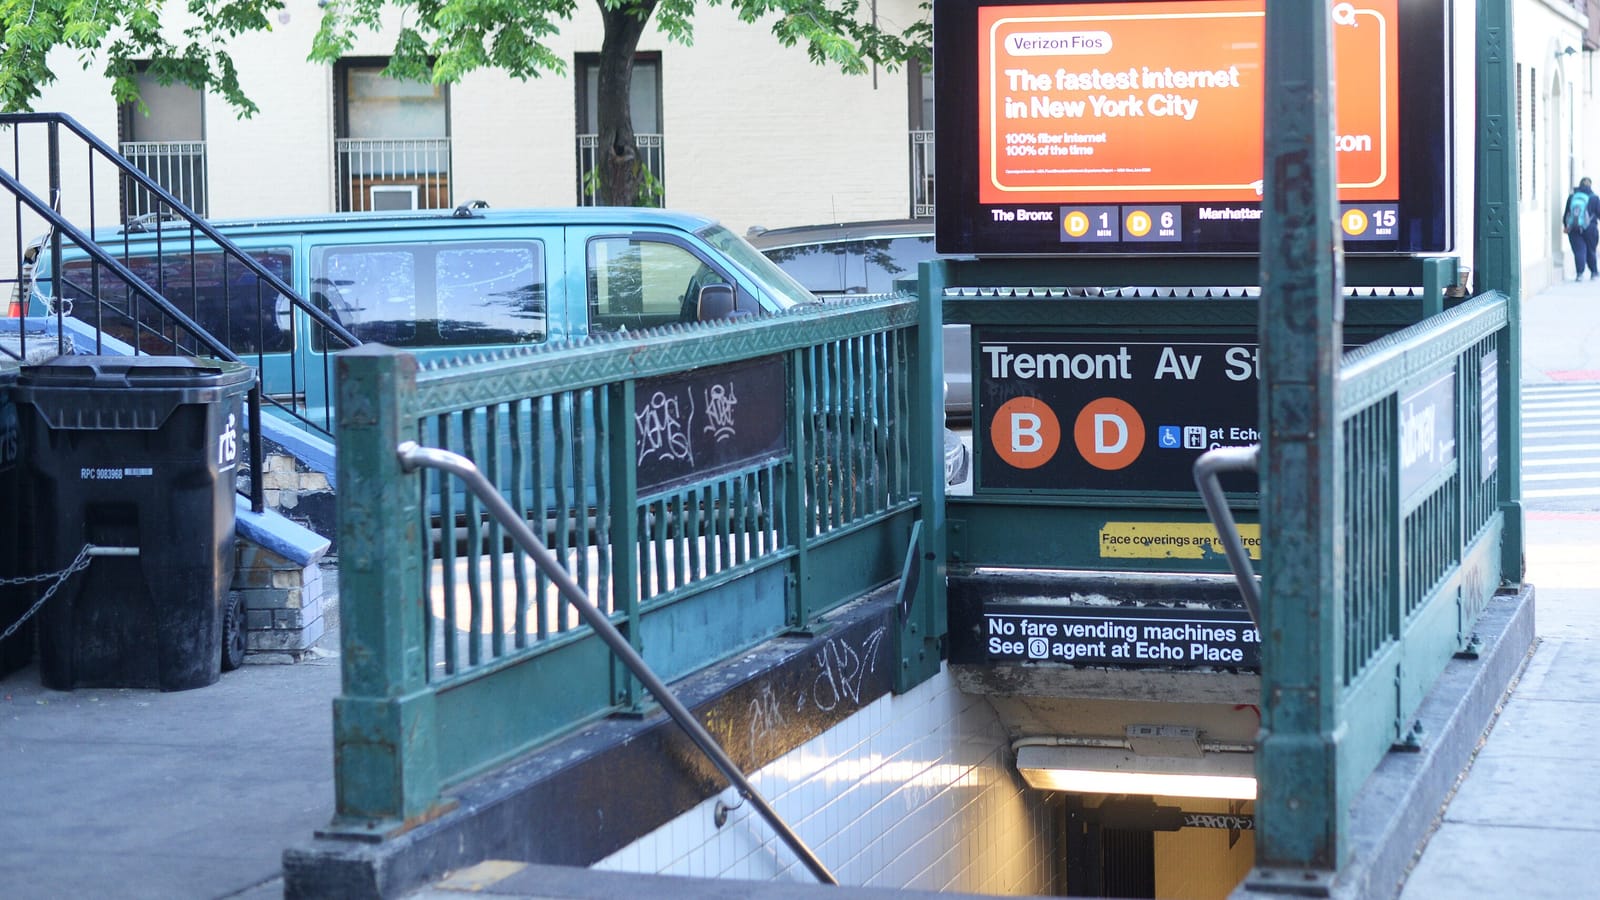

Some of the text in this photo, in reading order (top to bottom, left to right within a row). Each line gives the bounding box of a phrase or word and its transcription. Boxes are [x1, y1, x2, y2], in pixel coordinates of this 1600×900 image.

[1014, 36, 1103, 50] Verizon Fios
[1004, 66, 1240, 91] The fastest internet
[1005, 93, 1198, 120] in New York City
[1005, 132, 1107, 145] 100% fiber internet
[1005, 144, 1094, 156] 100% of the time
[991, 208, 1053, 221] The Bronx
[1098, 212, 1108, 229] 1
[1160, 211, 1174, 229] 6
[1348, 214, 1363, 231] D
[1372, 210, 1396, 227] 15
[1070, 216, 1085, 232] D
[1132, 216, 1147, 231] D
[1096, 229, 1111, 237] MIN
[982, 346, 1132, 380] Tremont
[1154, 347, 1202, 380] Av
[1010, 412, 1129, 454] B D
[1209, 427, 1224, 440] at
[218, 424, 236, 465] rts
[81, 467, 95, 480] RPC
[1102, 533, 1262, 547] Face coverings are rired
[988, 618, 1262, 643] No fare vending machines at
[988, 637, 1243, 662] See agent at Echo Place
